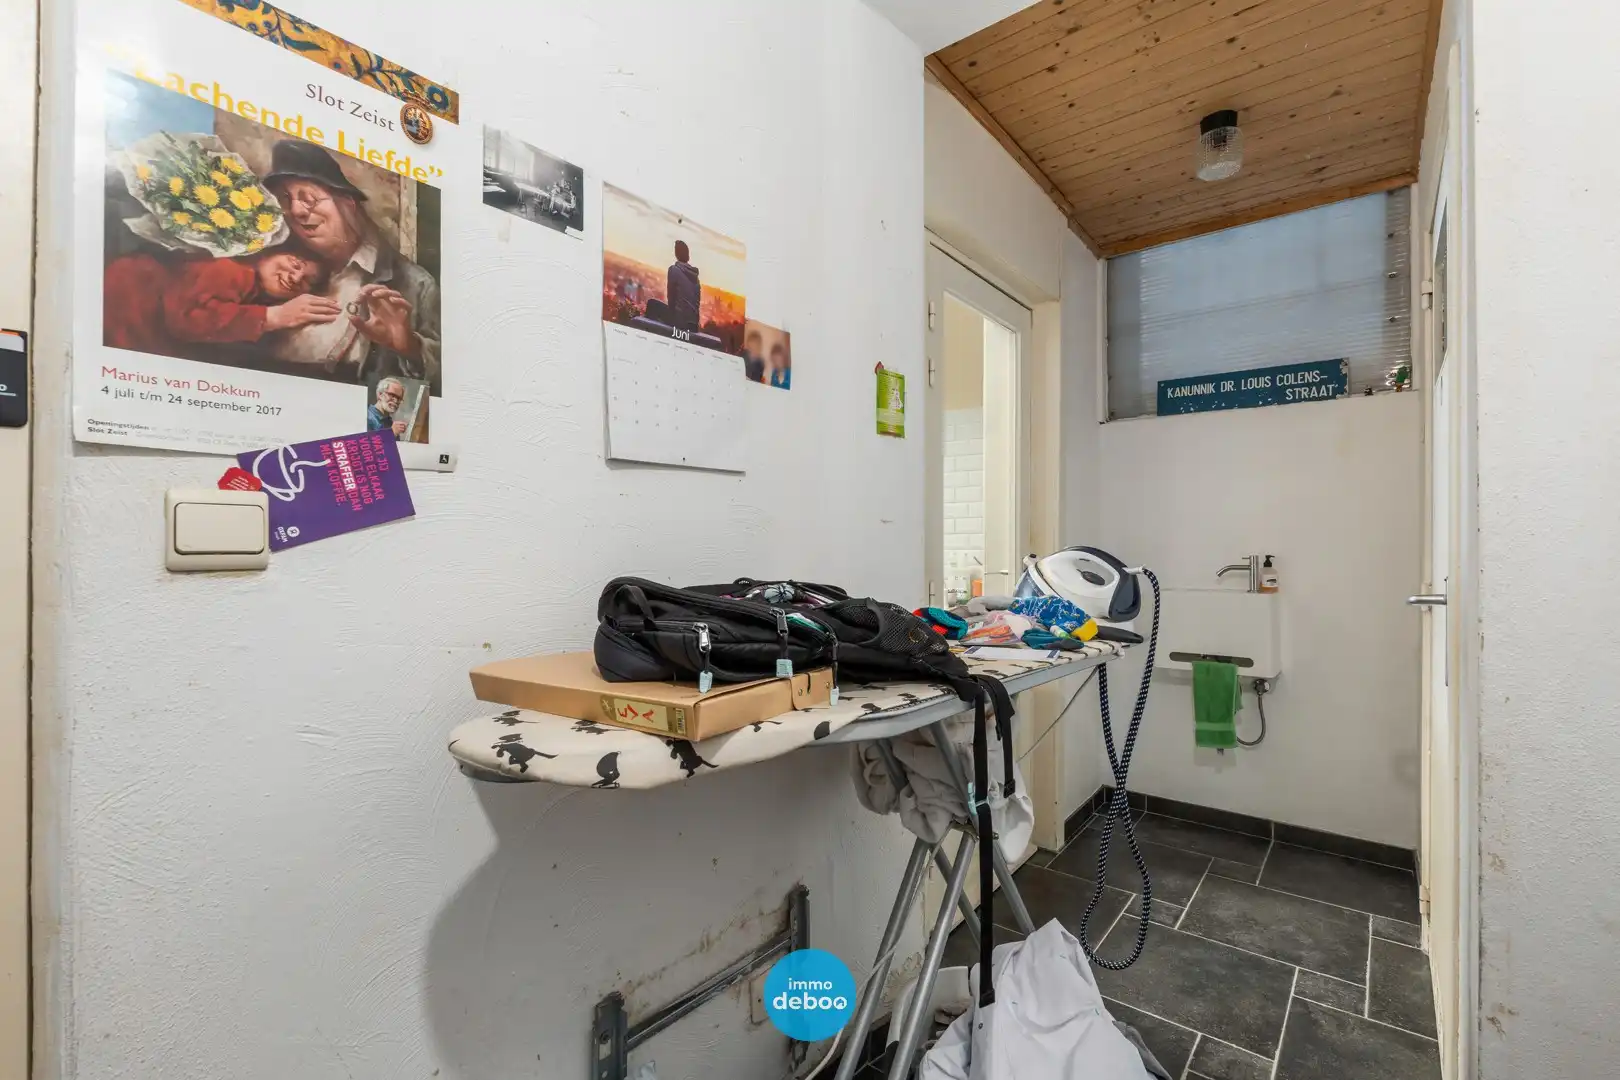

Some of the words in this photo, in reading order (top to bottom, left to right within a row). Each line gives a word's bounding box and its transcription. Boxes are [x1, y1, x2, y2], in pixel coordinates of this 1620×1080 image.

[305, 83, 344, 111] Slot
[350, 101, 395, 131] Zeist
[671, 325, 690, 341] Juni
[101, 365, 158, 385] Marius
[164, 378, 190, 389] van
[197, 379, 261, 399] Dokkum
[1167, 382, 1216, 399] KANUNNIK
[1220, 379, 1237, 393] DR.
[1241, 376, 1272, 391] LOUIS
[1276, 370, 1328, 387] COLENS-
[1285, 384, 1334, 401] STRAAT
[101, 385, 109, 395] 4
[114, 387, 135, 399] juli
[139, 390, 162, 403] t/m
[168, 394, 182, 404] 24
[187, 398, 251, 413] september
[256, 404, 282, 416] 2017
[333, 441, 356, 491] STRAFFER
